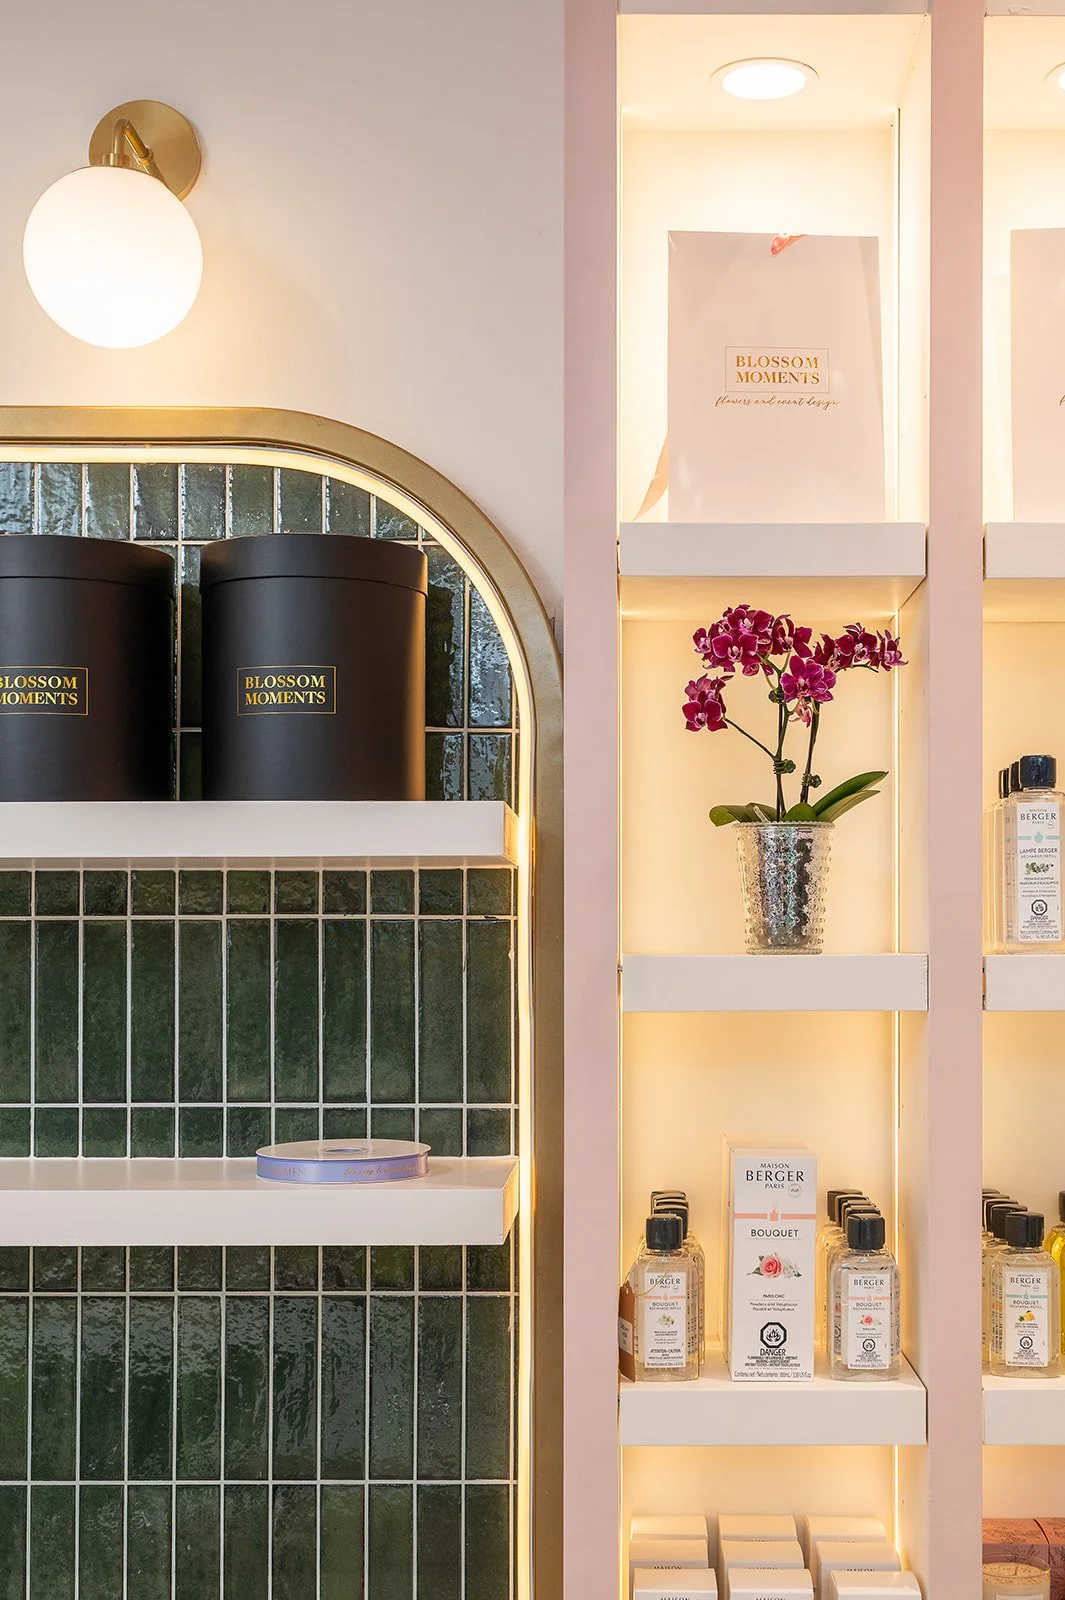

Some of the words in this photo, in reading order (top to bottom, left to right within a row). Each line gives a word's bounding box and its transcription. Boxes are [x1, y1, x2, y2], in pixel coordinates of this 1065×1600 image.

[736, 355, 819, 369] BLOSSOM
[736, 371, 820, 385] MOMENTS
[715, 395, 751, 407] flowers
[753, 396, 776, 406] and
[777, 397, 804, 406] event
[805, 396, 840, 410] design
[0, 676, 78, 689] LOSSOM
[244, 674, 326, 689] BLOSSOM
[244, 691, 326, 706] MOMENTS
[746, 1170, 805, 1182] BERGER
[751, 1229, 799, 1238] BOUQUET
[760, 1348, 786, 1356] DANGER
